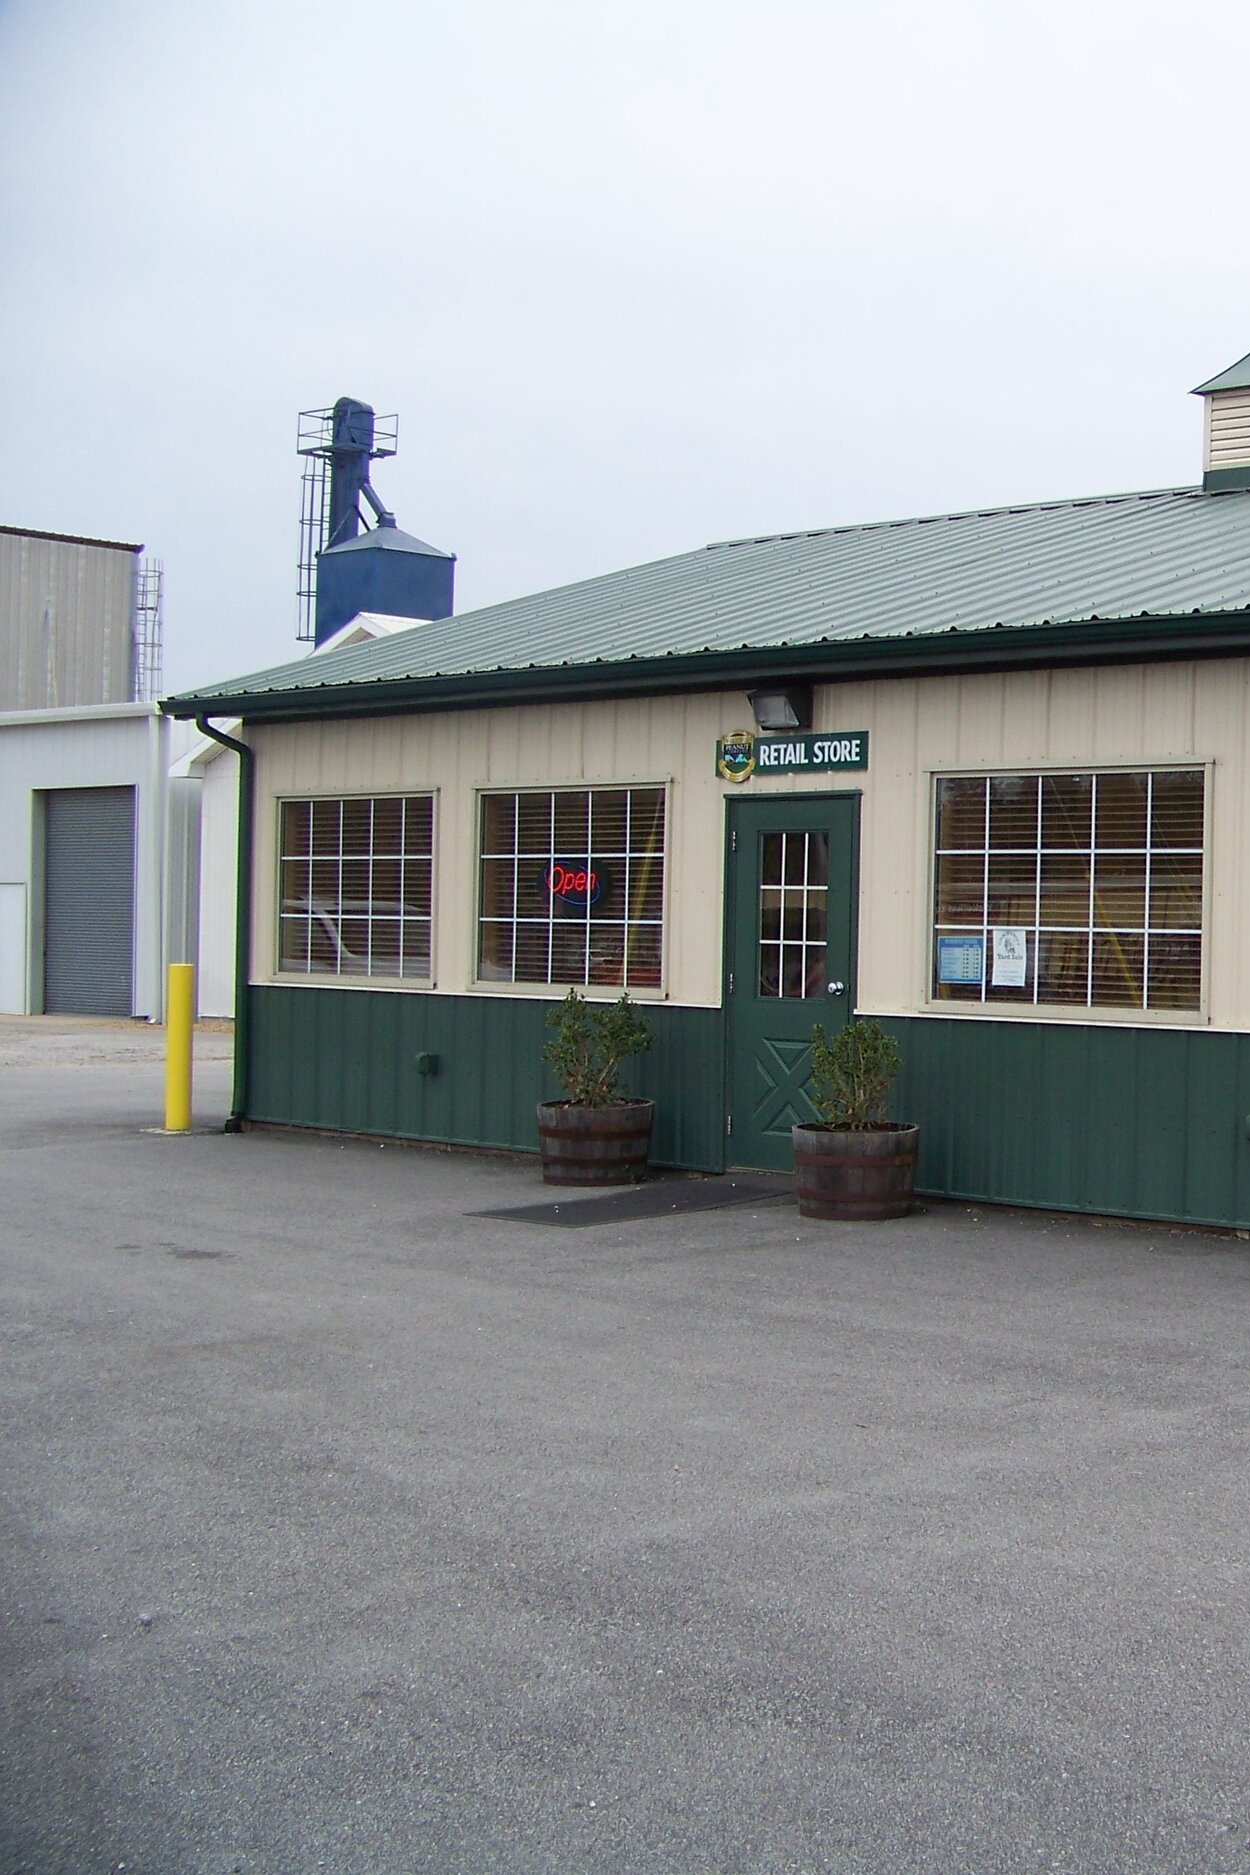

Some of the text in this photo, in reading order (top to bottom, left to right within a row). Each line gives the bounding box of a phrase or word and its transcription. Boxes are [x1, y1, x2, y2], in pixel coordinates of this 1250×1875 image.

[759, 739, 861, 766] RETAIL STORE
[548, 866, 596, 894] Open
